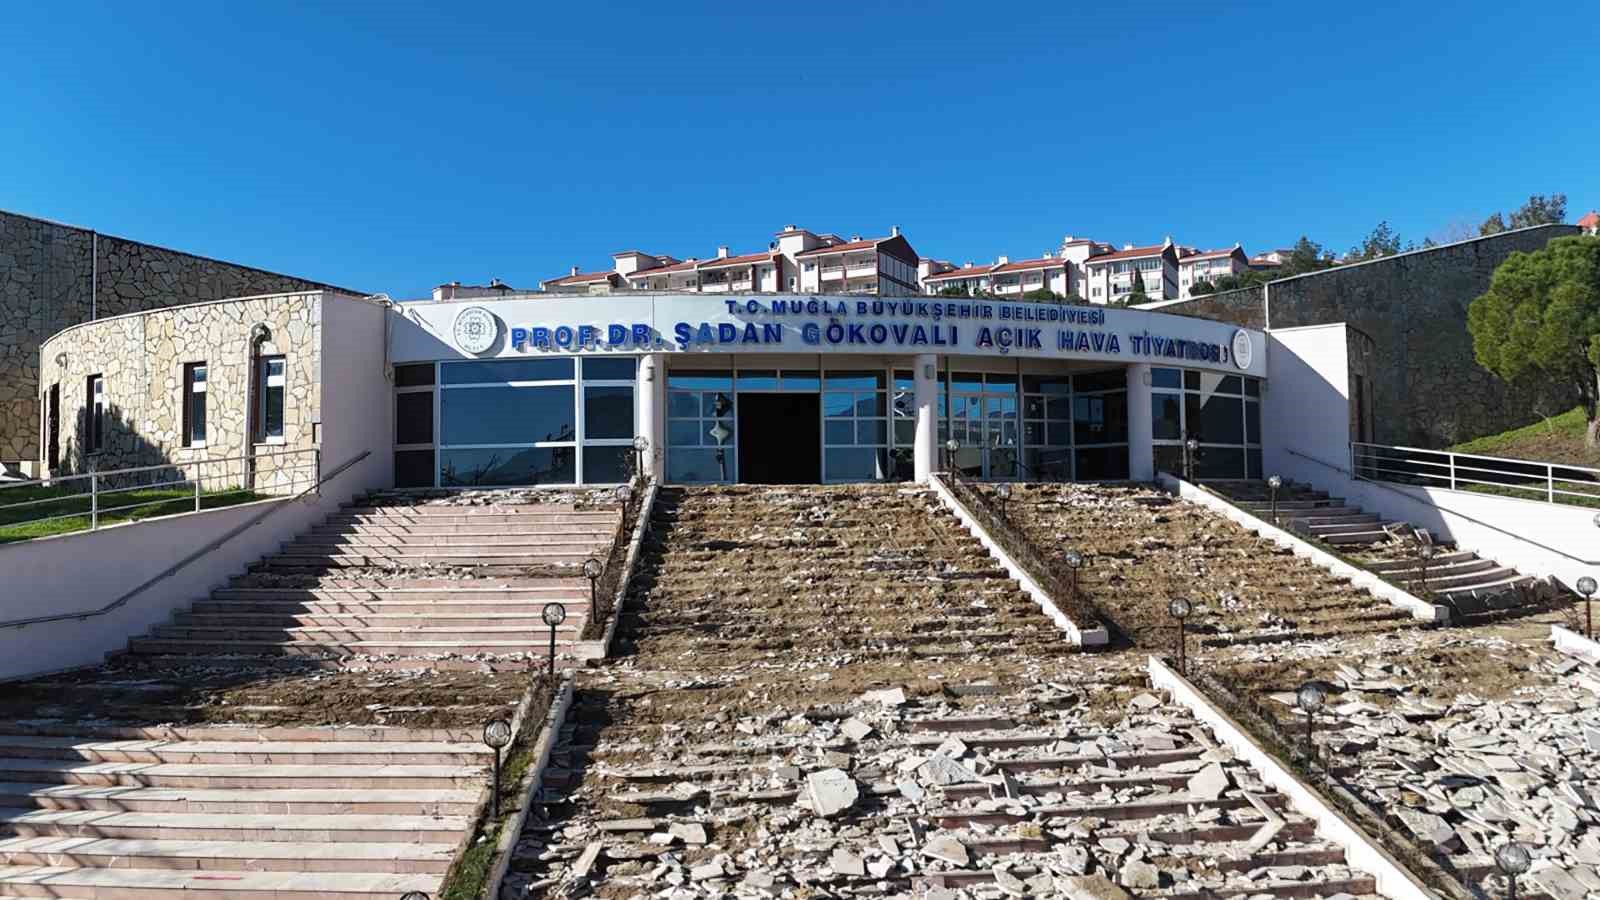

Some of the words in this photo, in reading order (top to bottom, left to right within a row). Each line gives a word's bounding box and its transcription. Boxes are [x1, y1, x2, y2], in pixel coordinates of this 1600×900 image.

[674, 322, 783, 351] ŞADAN
[802, 318, 958, 347] GÖKOVALI
[977, 327, 1042, 353] AÇIK
[1058, 331, 1120, 354] HAVA
